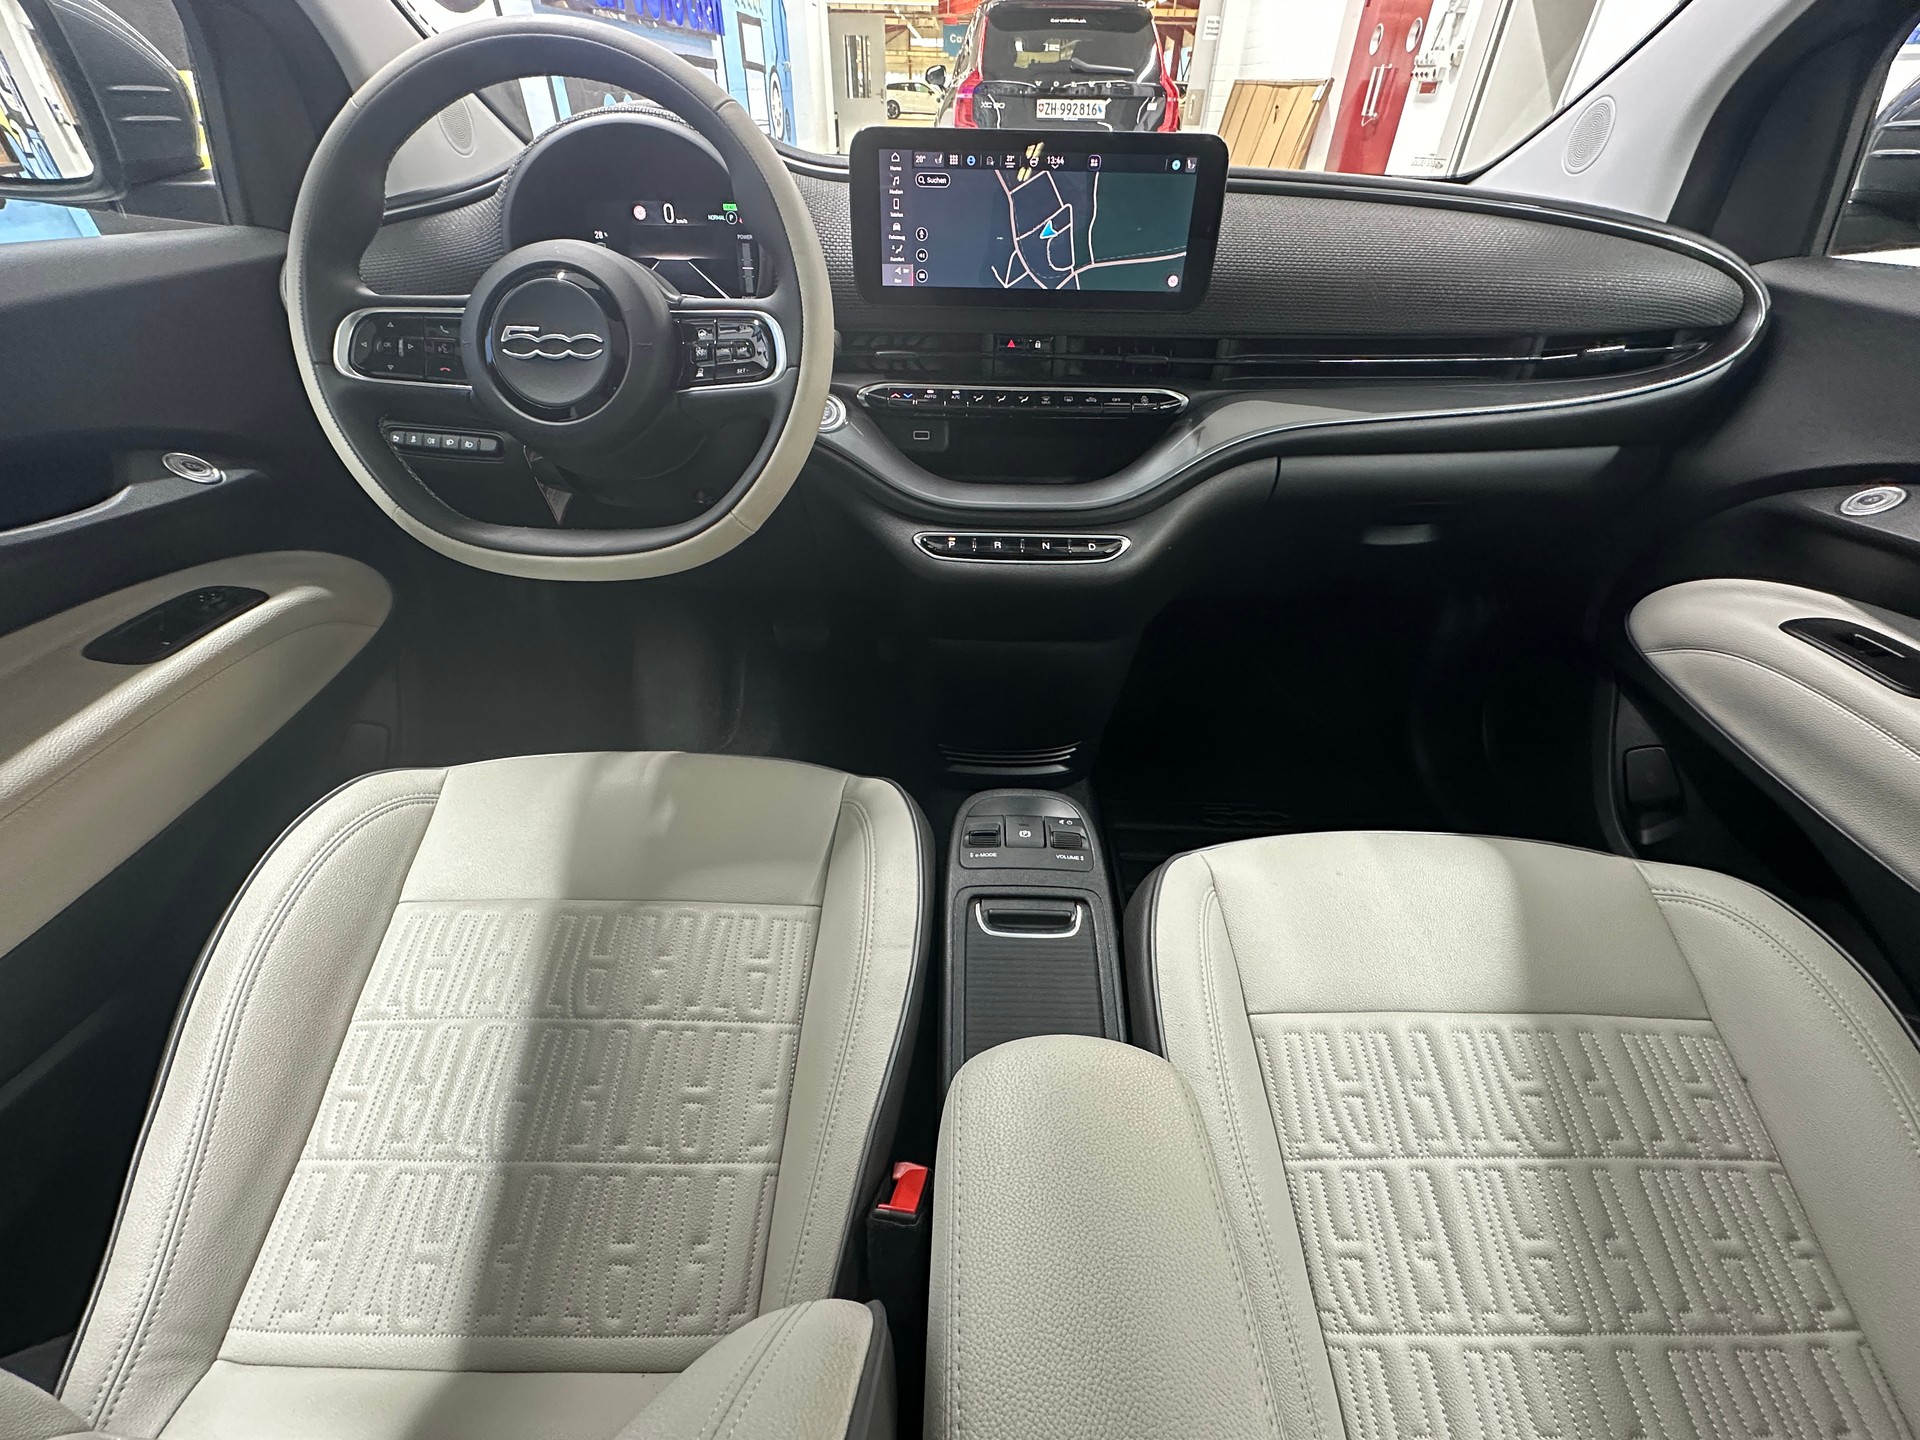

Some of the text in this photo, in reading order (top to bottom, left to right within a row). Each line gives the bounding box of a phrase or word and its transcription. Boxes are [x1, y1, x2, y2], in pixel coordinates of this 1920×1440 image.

[926, 176, 947, 185] Suchen
[663, 202, 675, 224] 0
[500, 324, 604, 361] 500
[948, 541, 1096, 551] P R N D
[1055, 854, 1080, 862] VOLUME
